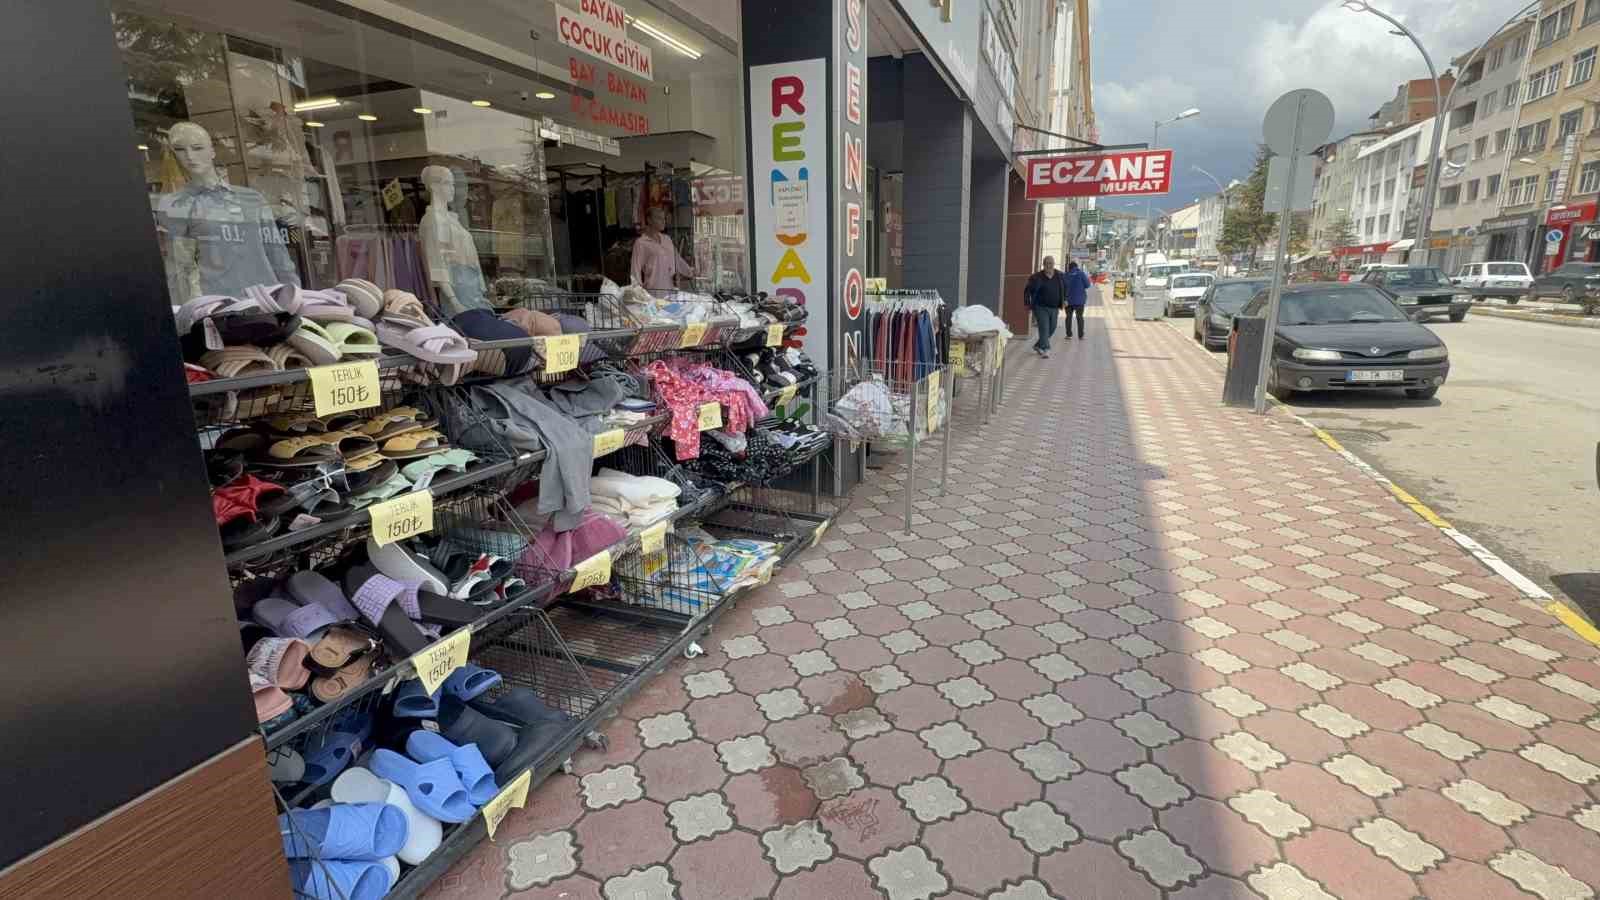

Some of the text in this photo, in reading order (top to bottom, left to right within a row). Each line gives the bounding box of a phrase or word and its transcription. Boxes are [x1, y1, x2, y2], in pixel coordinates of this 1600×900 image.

[580, 0, 625, 31] BAYAN
[560, 16, 612, 58] ÇOCUK
[568, 56, 594, 85] BAY
[607, 71, 648, 104] BAYAN
[1032, 154, 1167, 186] ECZANE
[1100, 179, 1164, 193] MURAT
